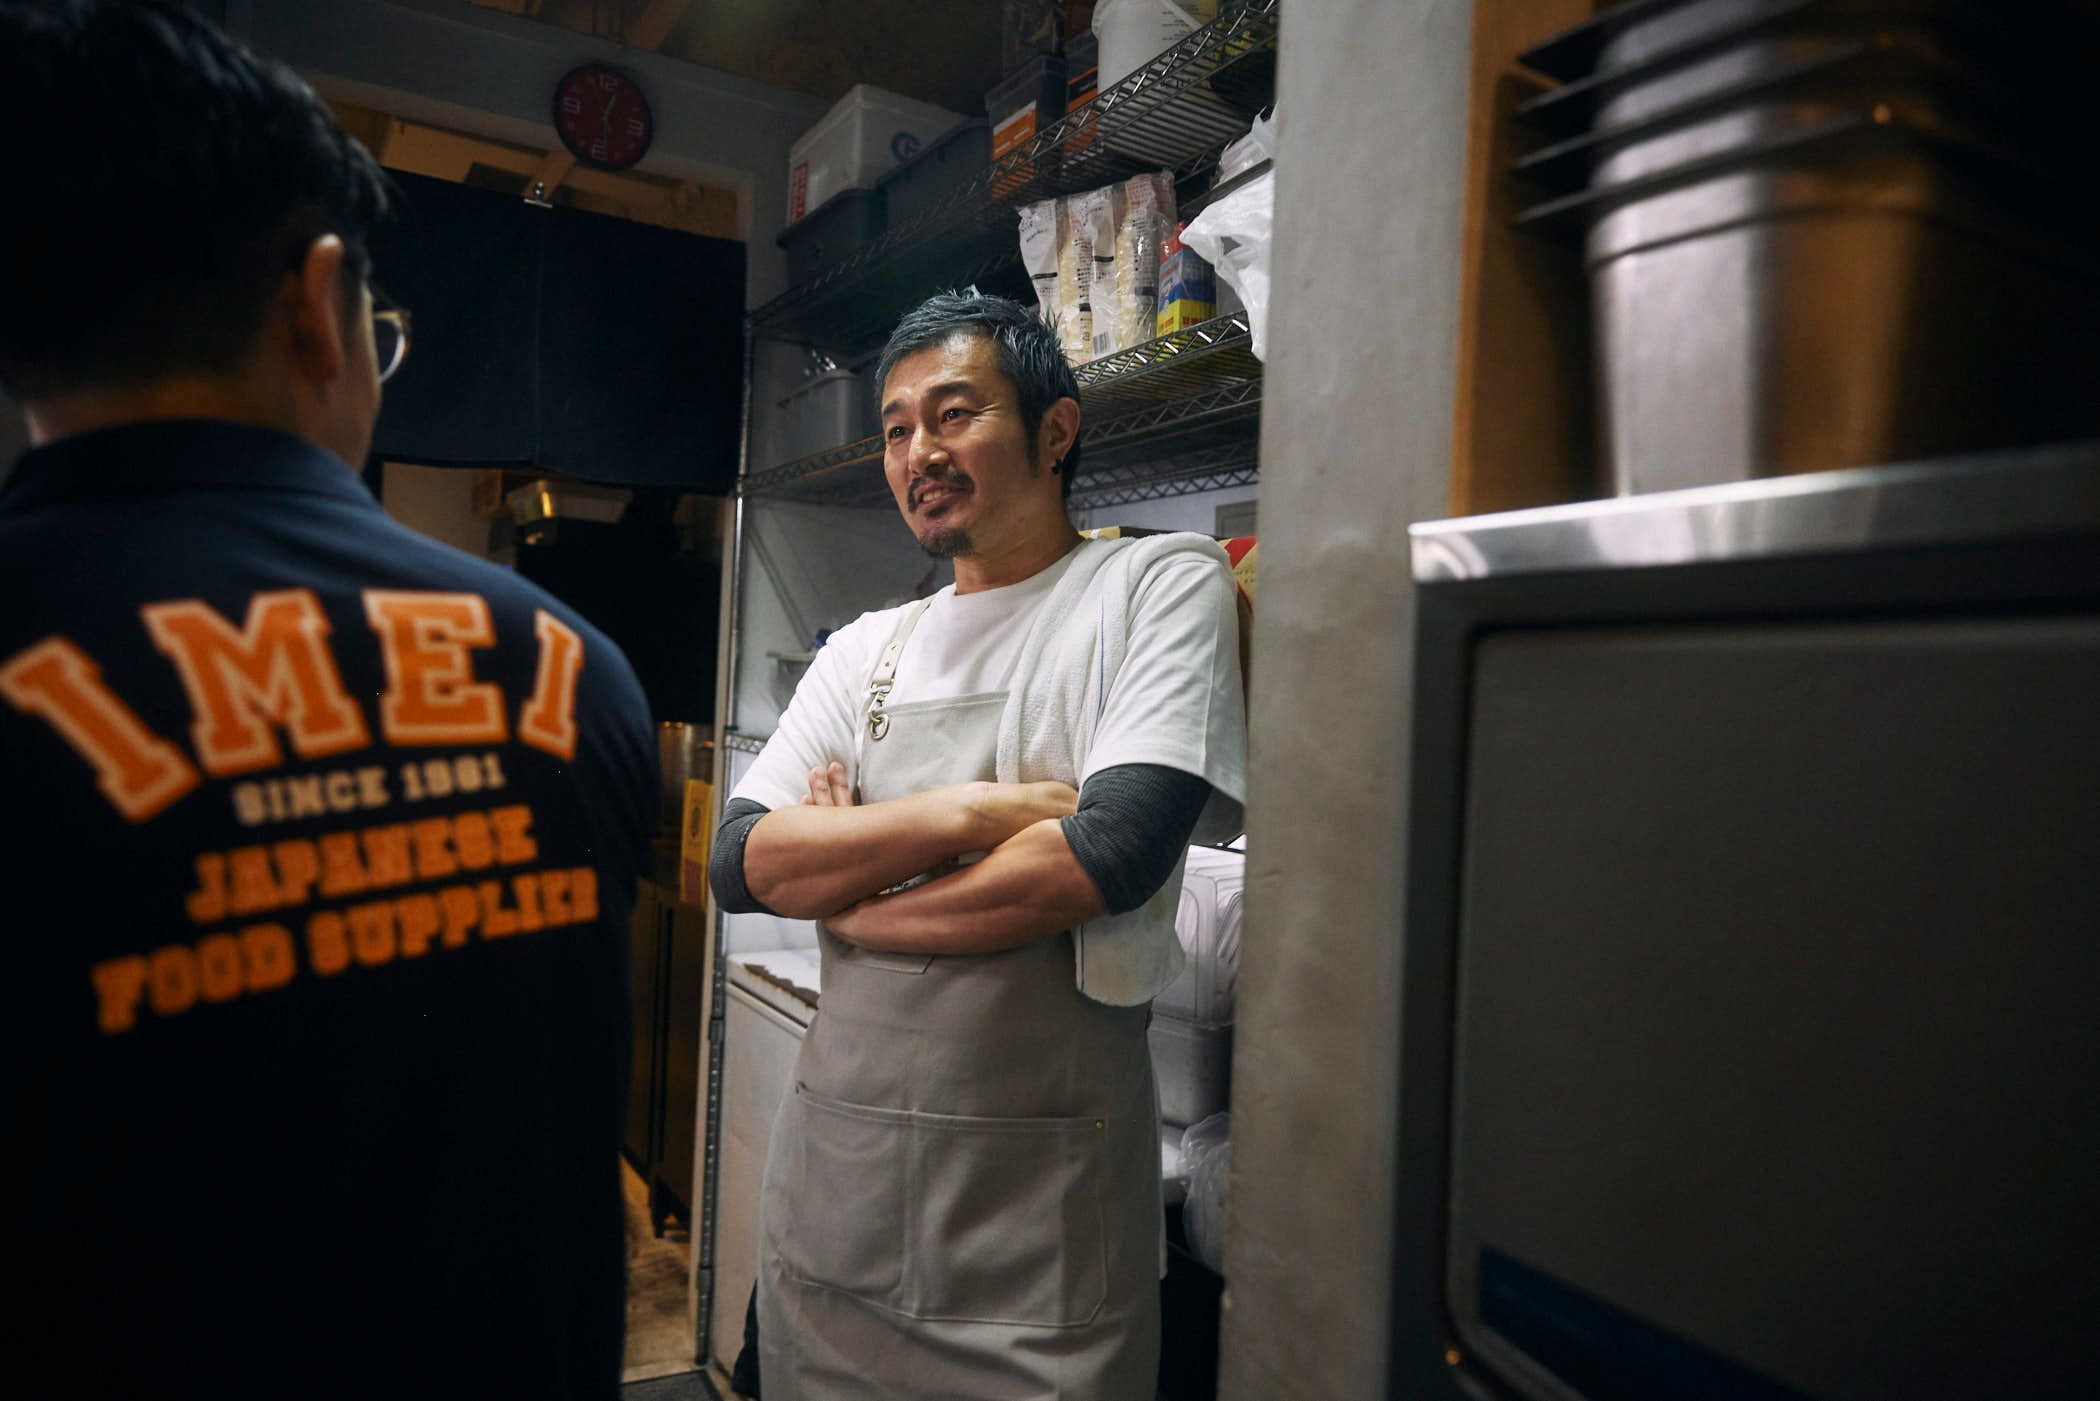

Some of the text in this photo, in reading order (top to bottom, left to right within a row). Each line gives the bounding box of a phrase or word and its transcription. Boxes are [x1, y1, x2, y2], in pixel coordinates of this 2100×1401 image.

[599, 73, 618, 94] 12
[0, 587, 584, 820] IMEI
[235, 768, 389, 822] SINCE
[189, 805, 537, 920] JAPANESE
[96, 868, 598, 1029] FOOD SUPPLIER
